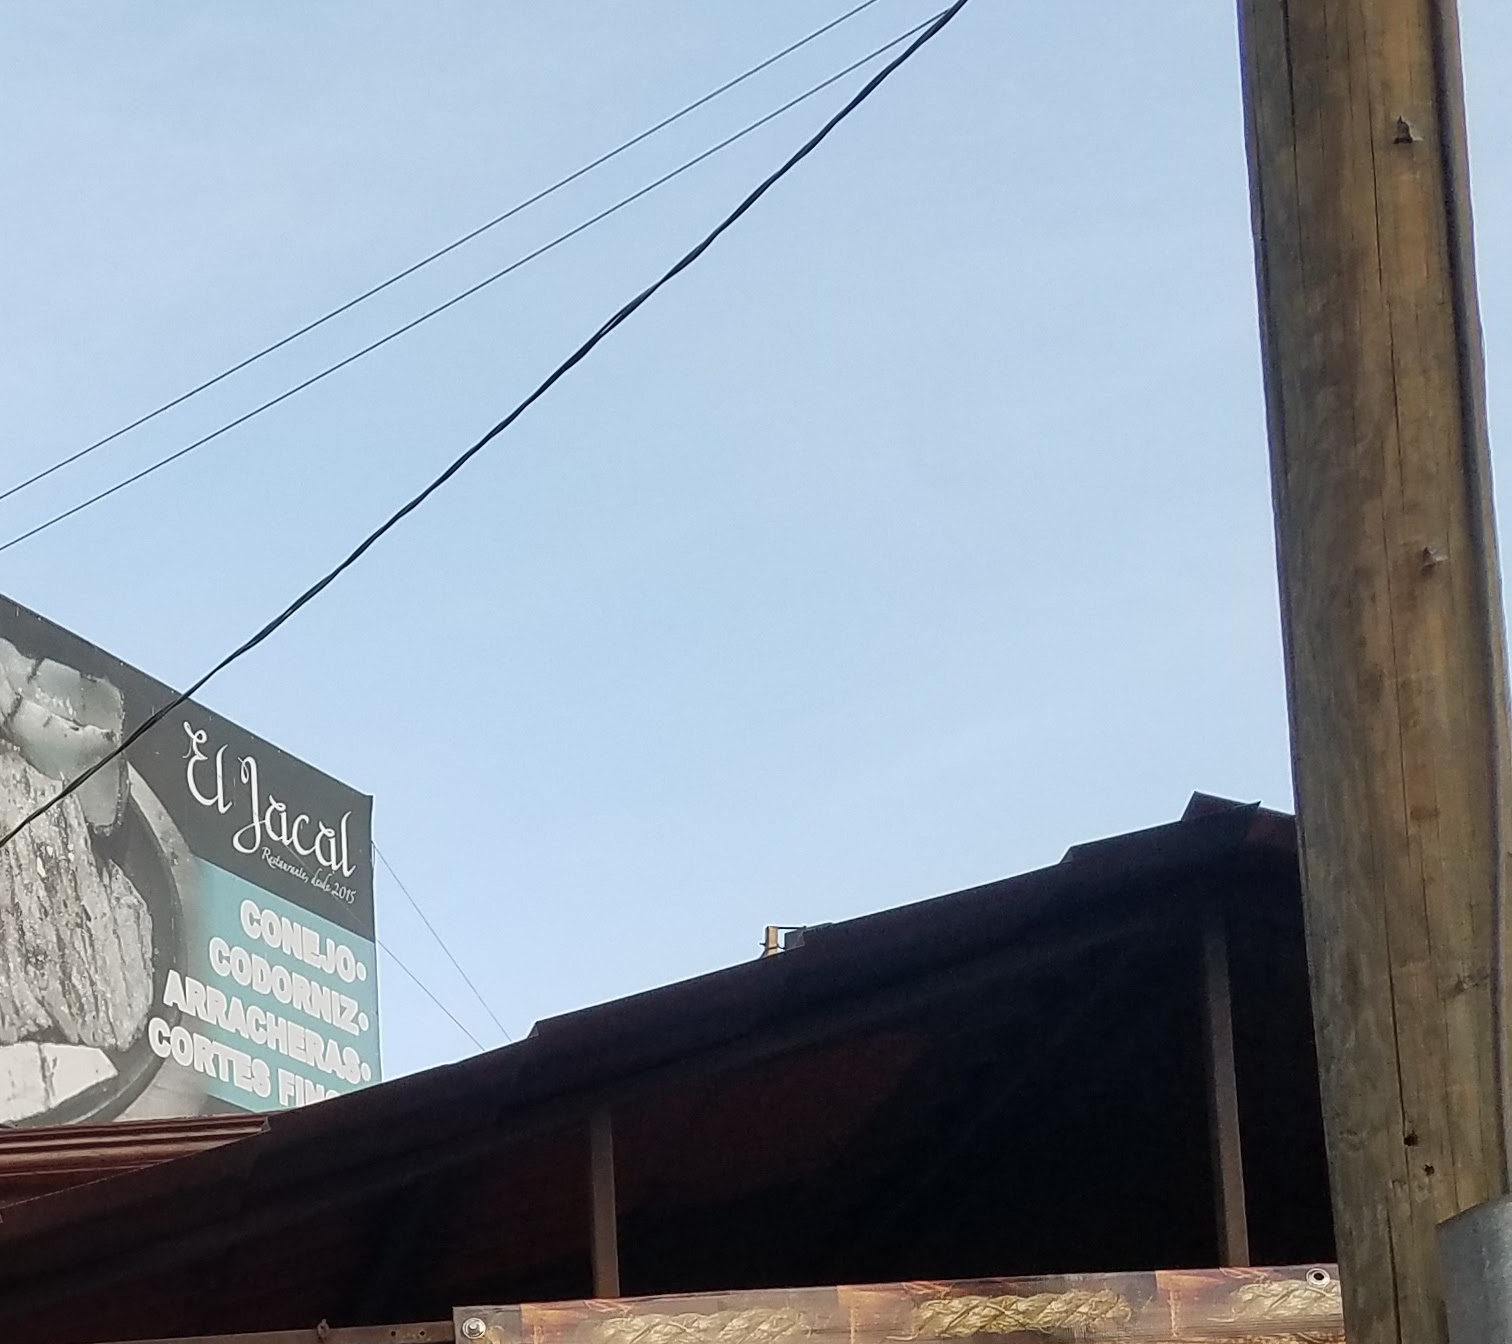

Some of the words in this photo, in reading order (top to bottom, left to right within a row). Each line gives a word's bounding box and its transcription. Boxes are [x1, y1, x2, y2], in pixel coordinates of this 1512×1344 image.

[183, 721, 233, 814] El
[232, 755, 356, 878] Jacal
[331, 882, 356, 904] 2015
[209, 937, 360, 1036] CODORNIZ
[240, 900, 358, 984] CONEJO
[148, 1017, 271, 1098] CORTES
[162, 970, 361, 1084] ARRACHERAS
